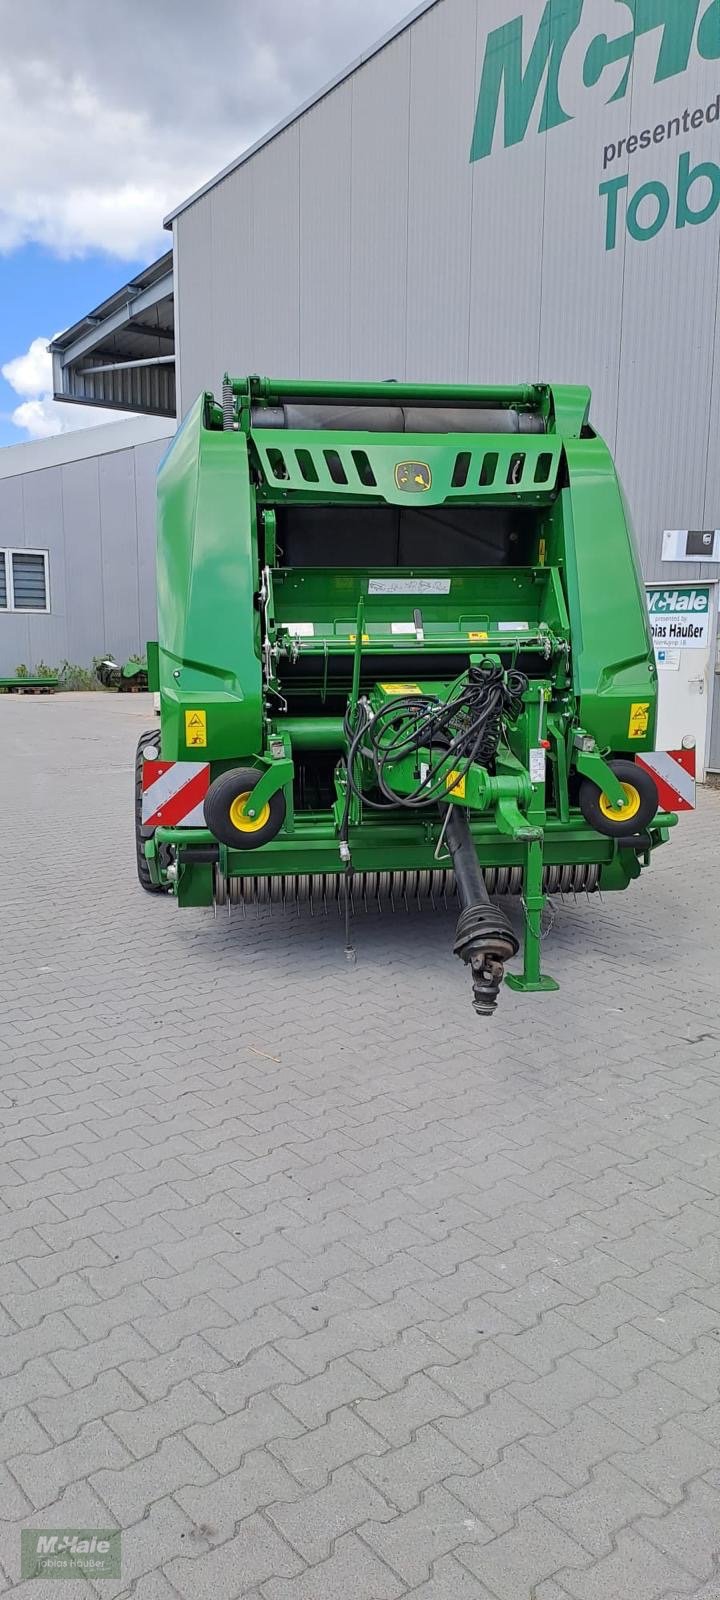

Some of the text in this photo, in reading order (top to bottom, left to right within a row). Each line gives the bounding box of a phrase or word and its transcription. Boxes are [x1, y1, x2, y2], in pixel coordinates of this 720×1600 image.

[603, 95, 720, 169] presented
[599, 151, 720, 251] Tob
[669, 623, 704, 638] Häußer
